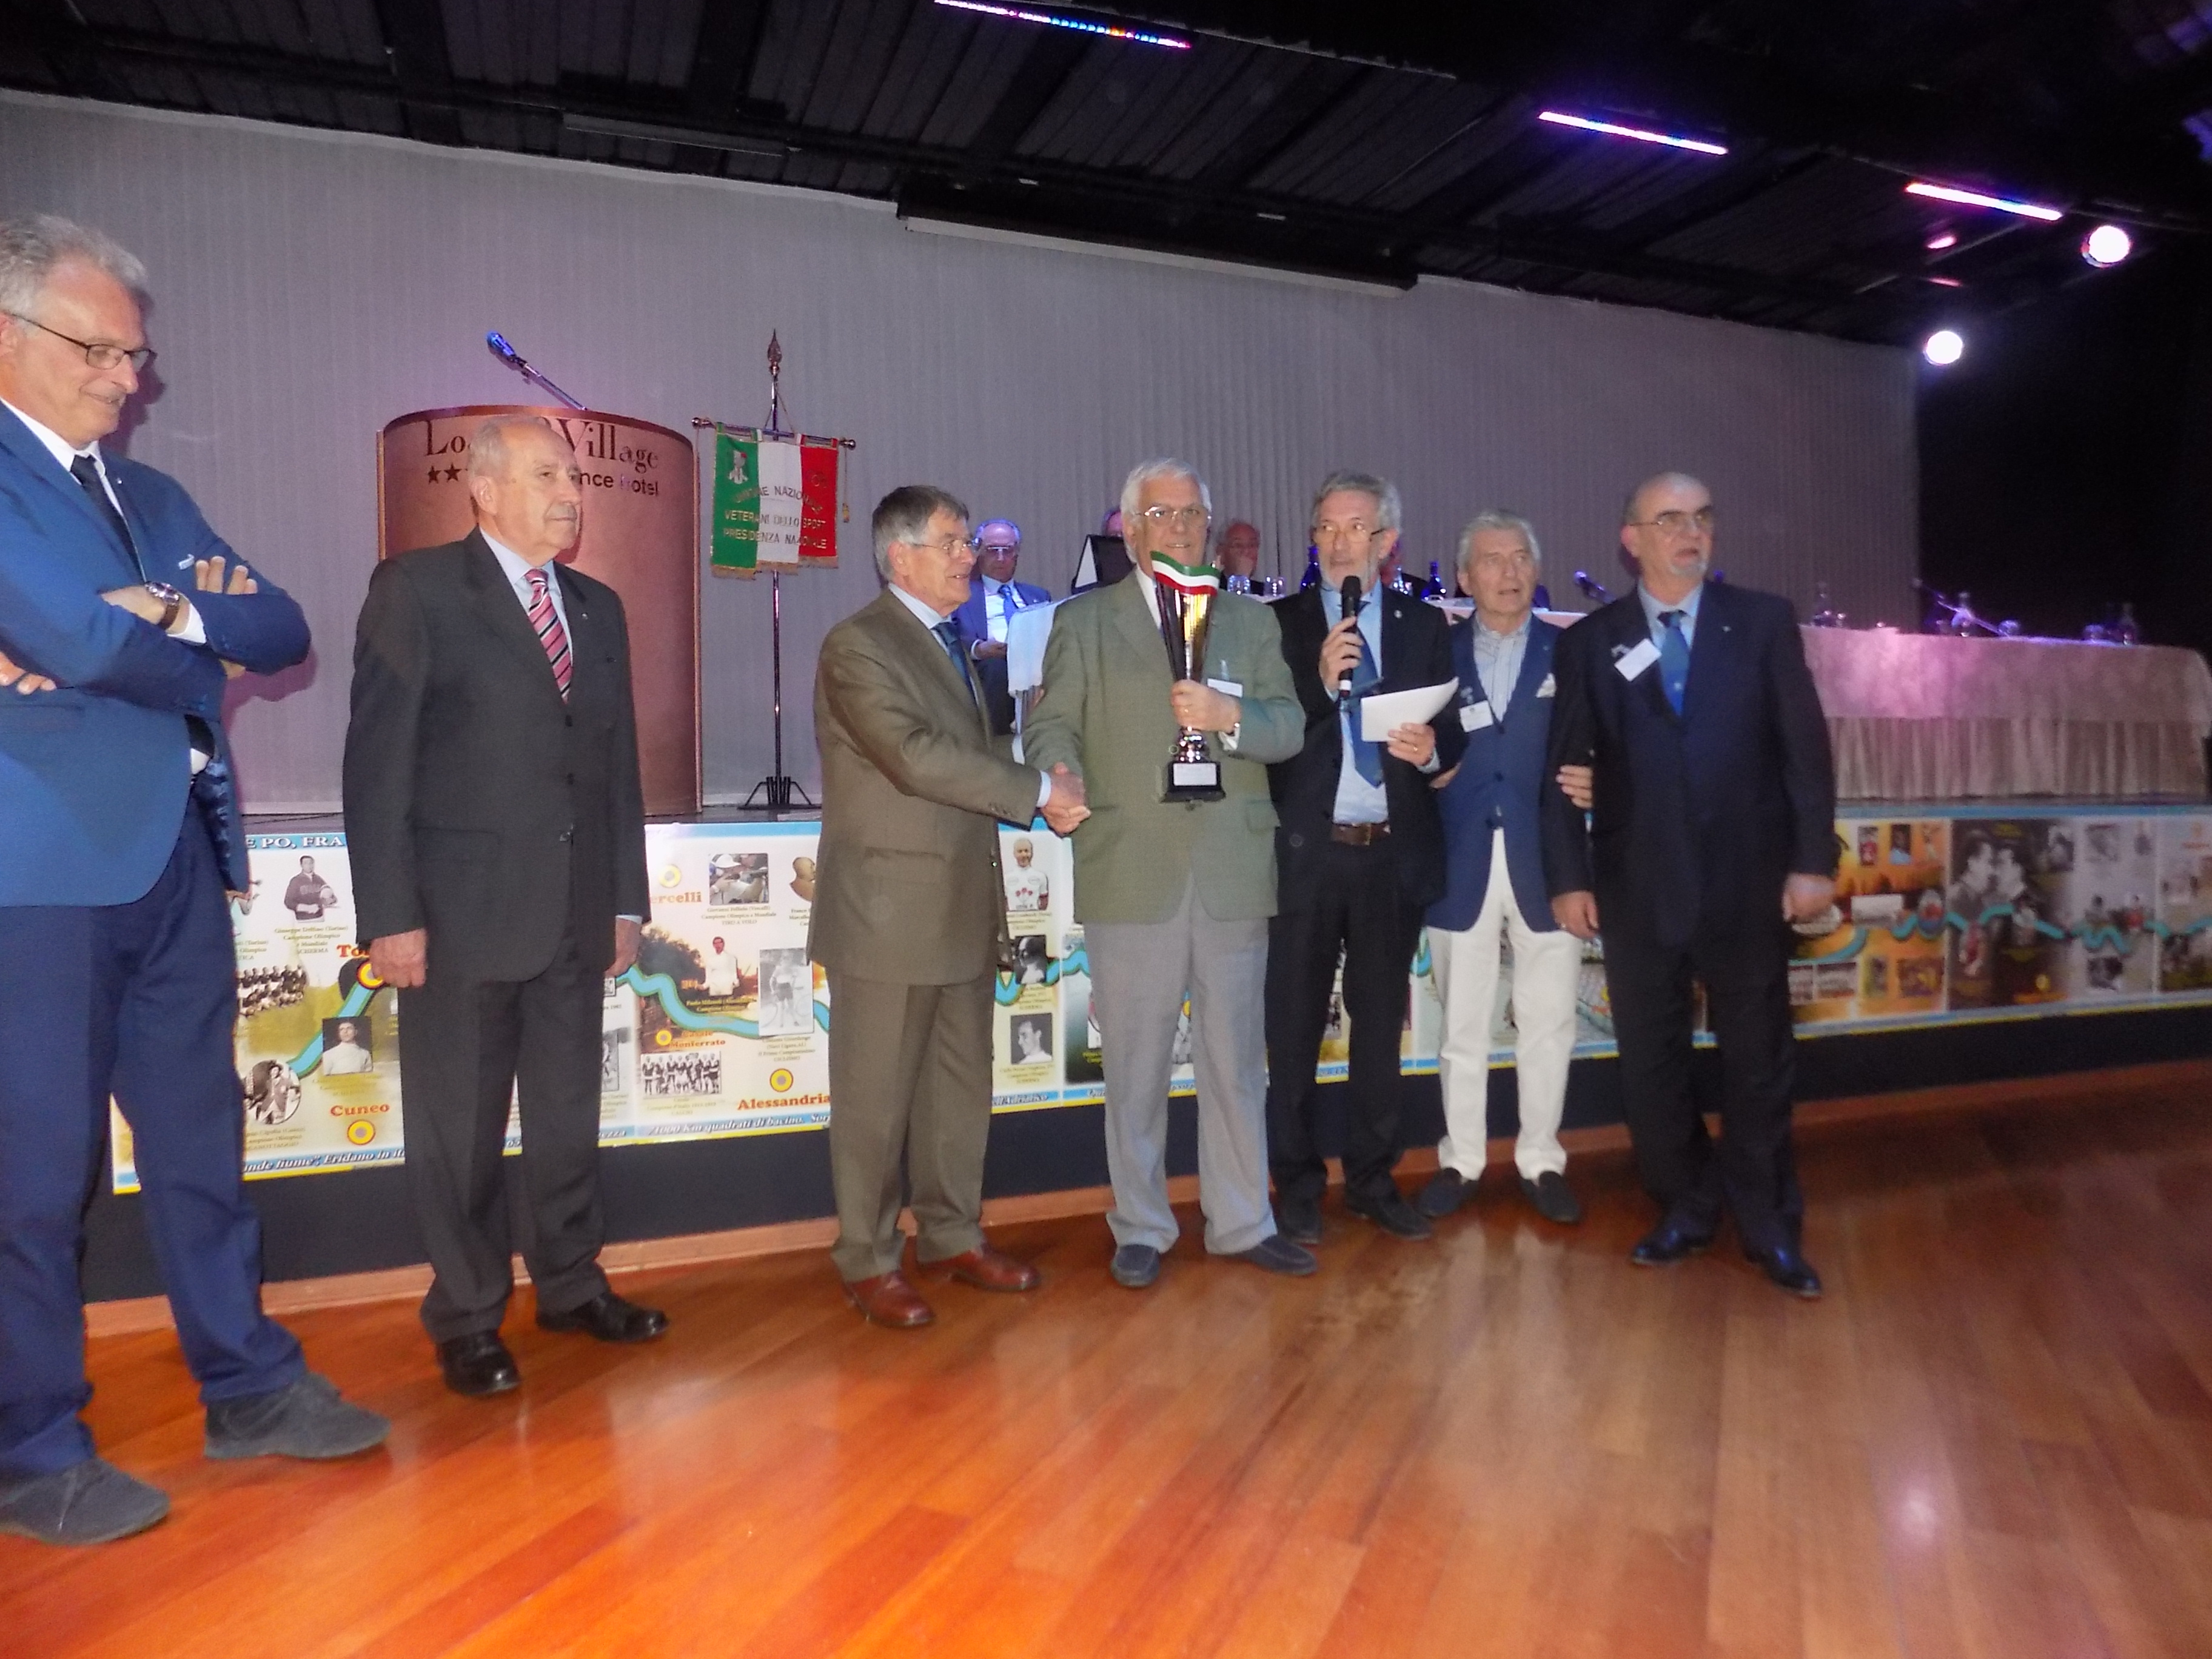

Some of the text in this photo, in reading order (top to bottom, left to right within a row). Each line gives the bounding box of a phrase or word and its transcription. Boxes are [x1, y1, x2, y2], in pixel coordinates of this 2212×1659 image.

[246, 838, 256, 848] E
[261, 837, 297, 849] PO,
[651, 891, 702, 904] ercelli
[737, 1093, 830, 1110] Alessandria
[330, 1103, 390, 1117] Cuneo
[323, 1153, 375, 1164] Eridano
[377, 1150, 390, 1160] in
